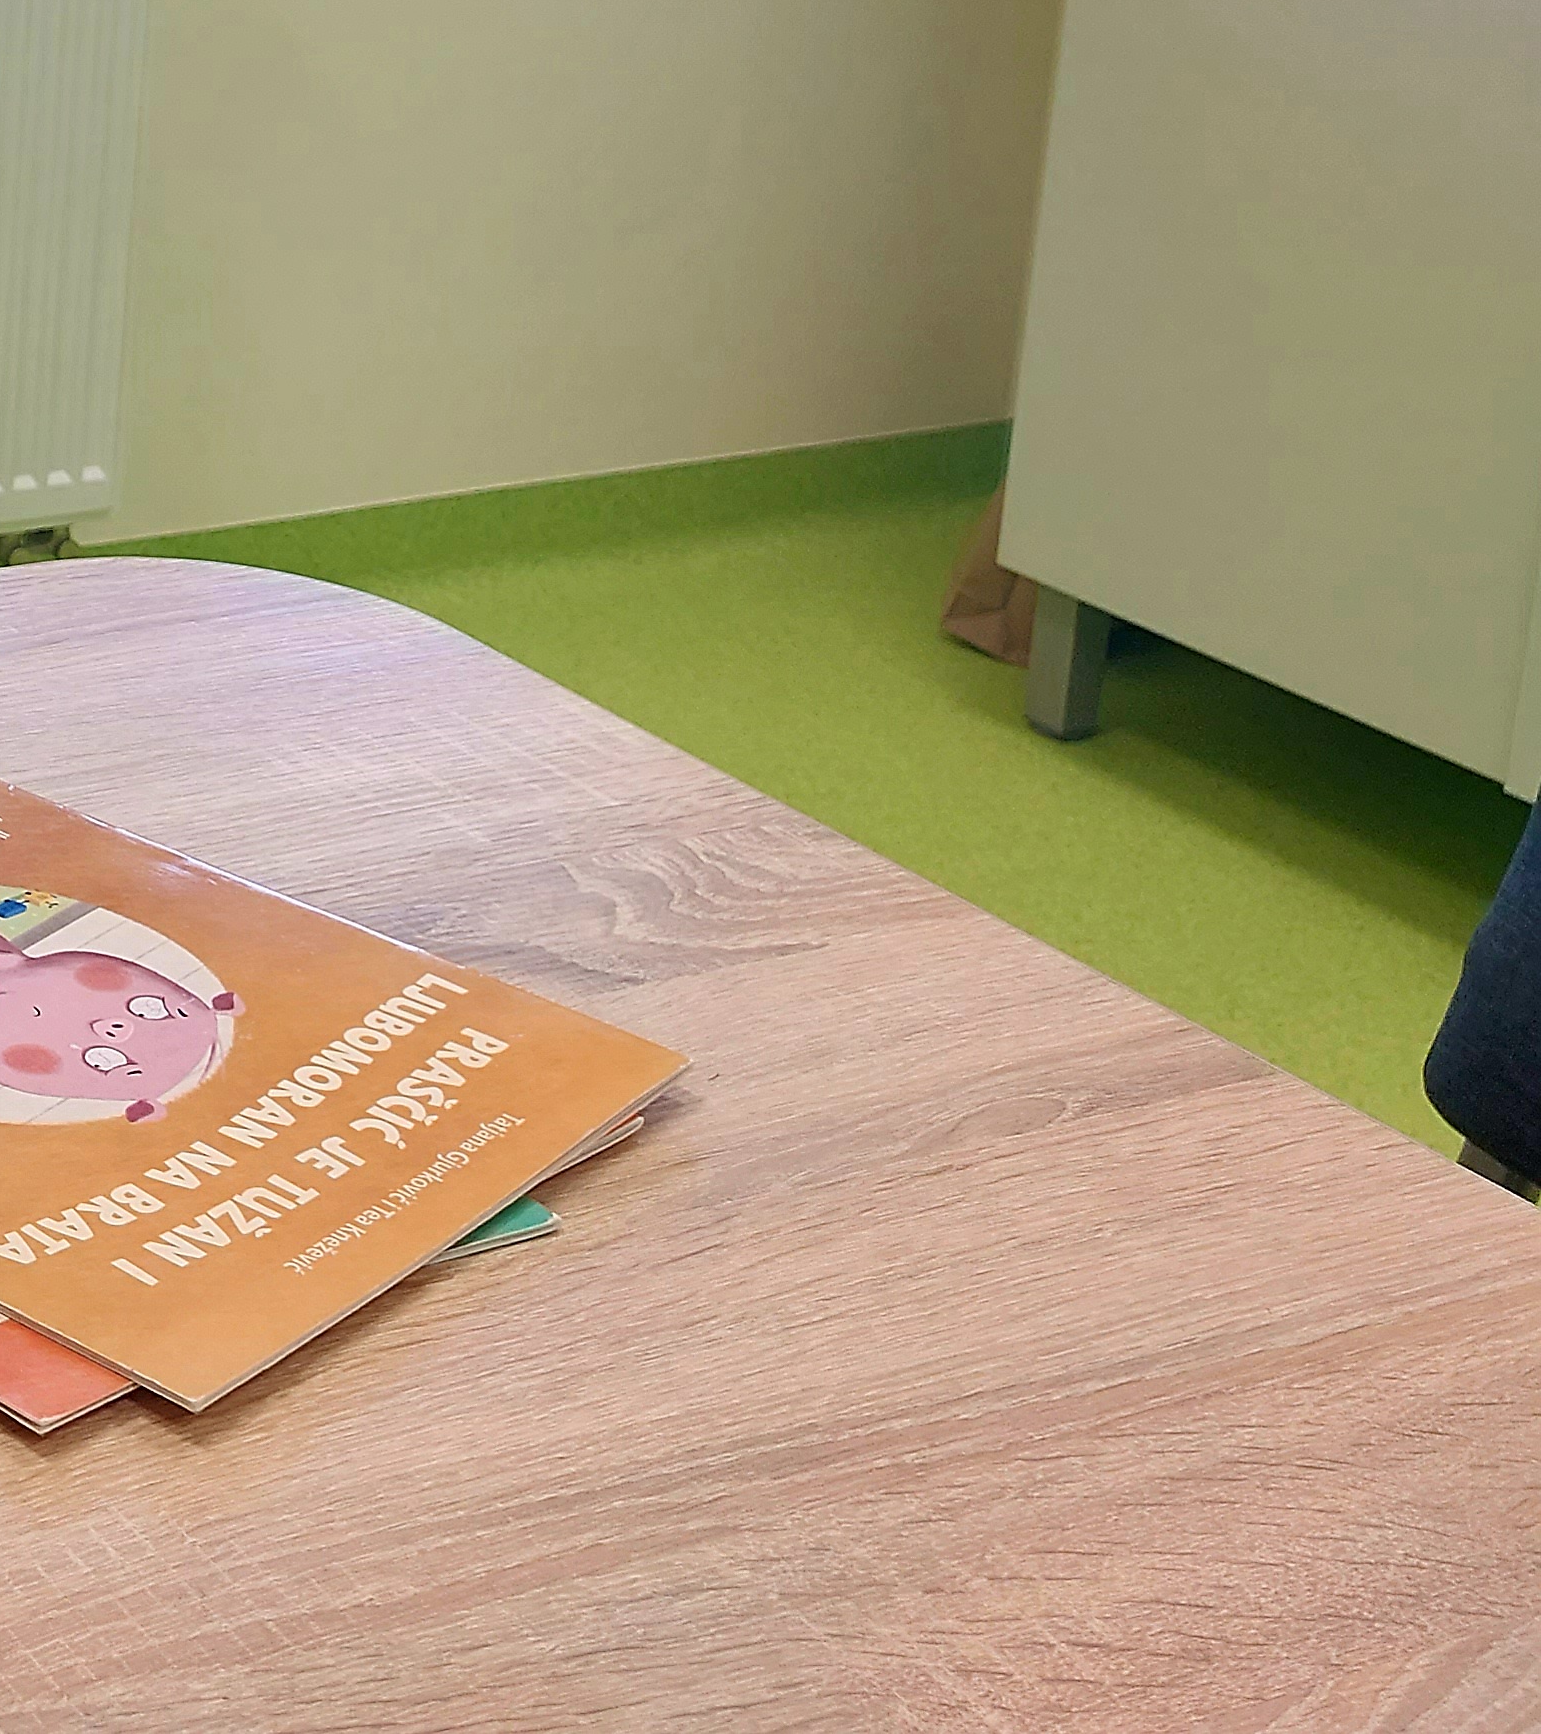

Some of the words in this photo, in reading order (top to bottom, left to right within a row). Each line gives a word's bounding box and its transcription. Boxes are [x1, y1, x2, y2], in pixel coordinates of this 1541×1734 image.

[217, 971, 469, 1150] LJUBOMORAN
[349, 1026, 510, 1149] PRAŠČIĆ
[293, 1135, 367, 1180] JE
[460, 1113, 525, 1153] Tatjana
[143, 1141, 238, 1192] NA
[389, 1153, 469, 1206] Gjurković
[143, 1173, 320, 1269] TUŽAN
[354, 1205, 396, 1226] Tea
[110, 1257, 160, 1287] I
[283, 1222, 366, 1276] Knežević
